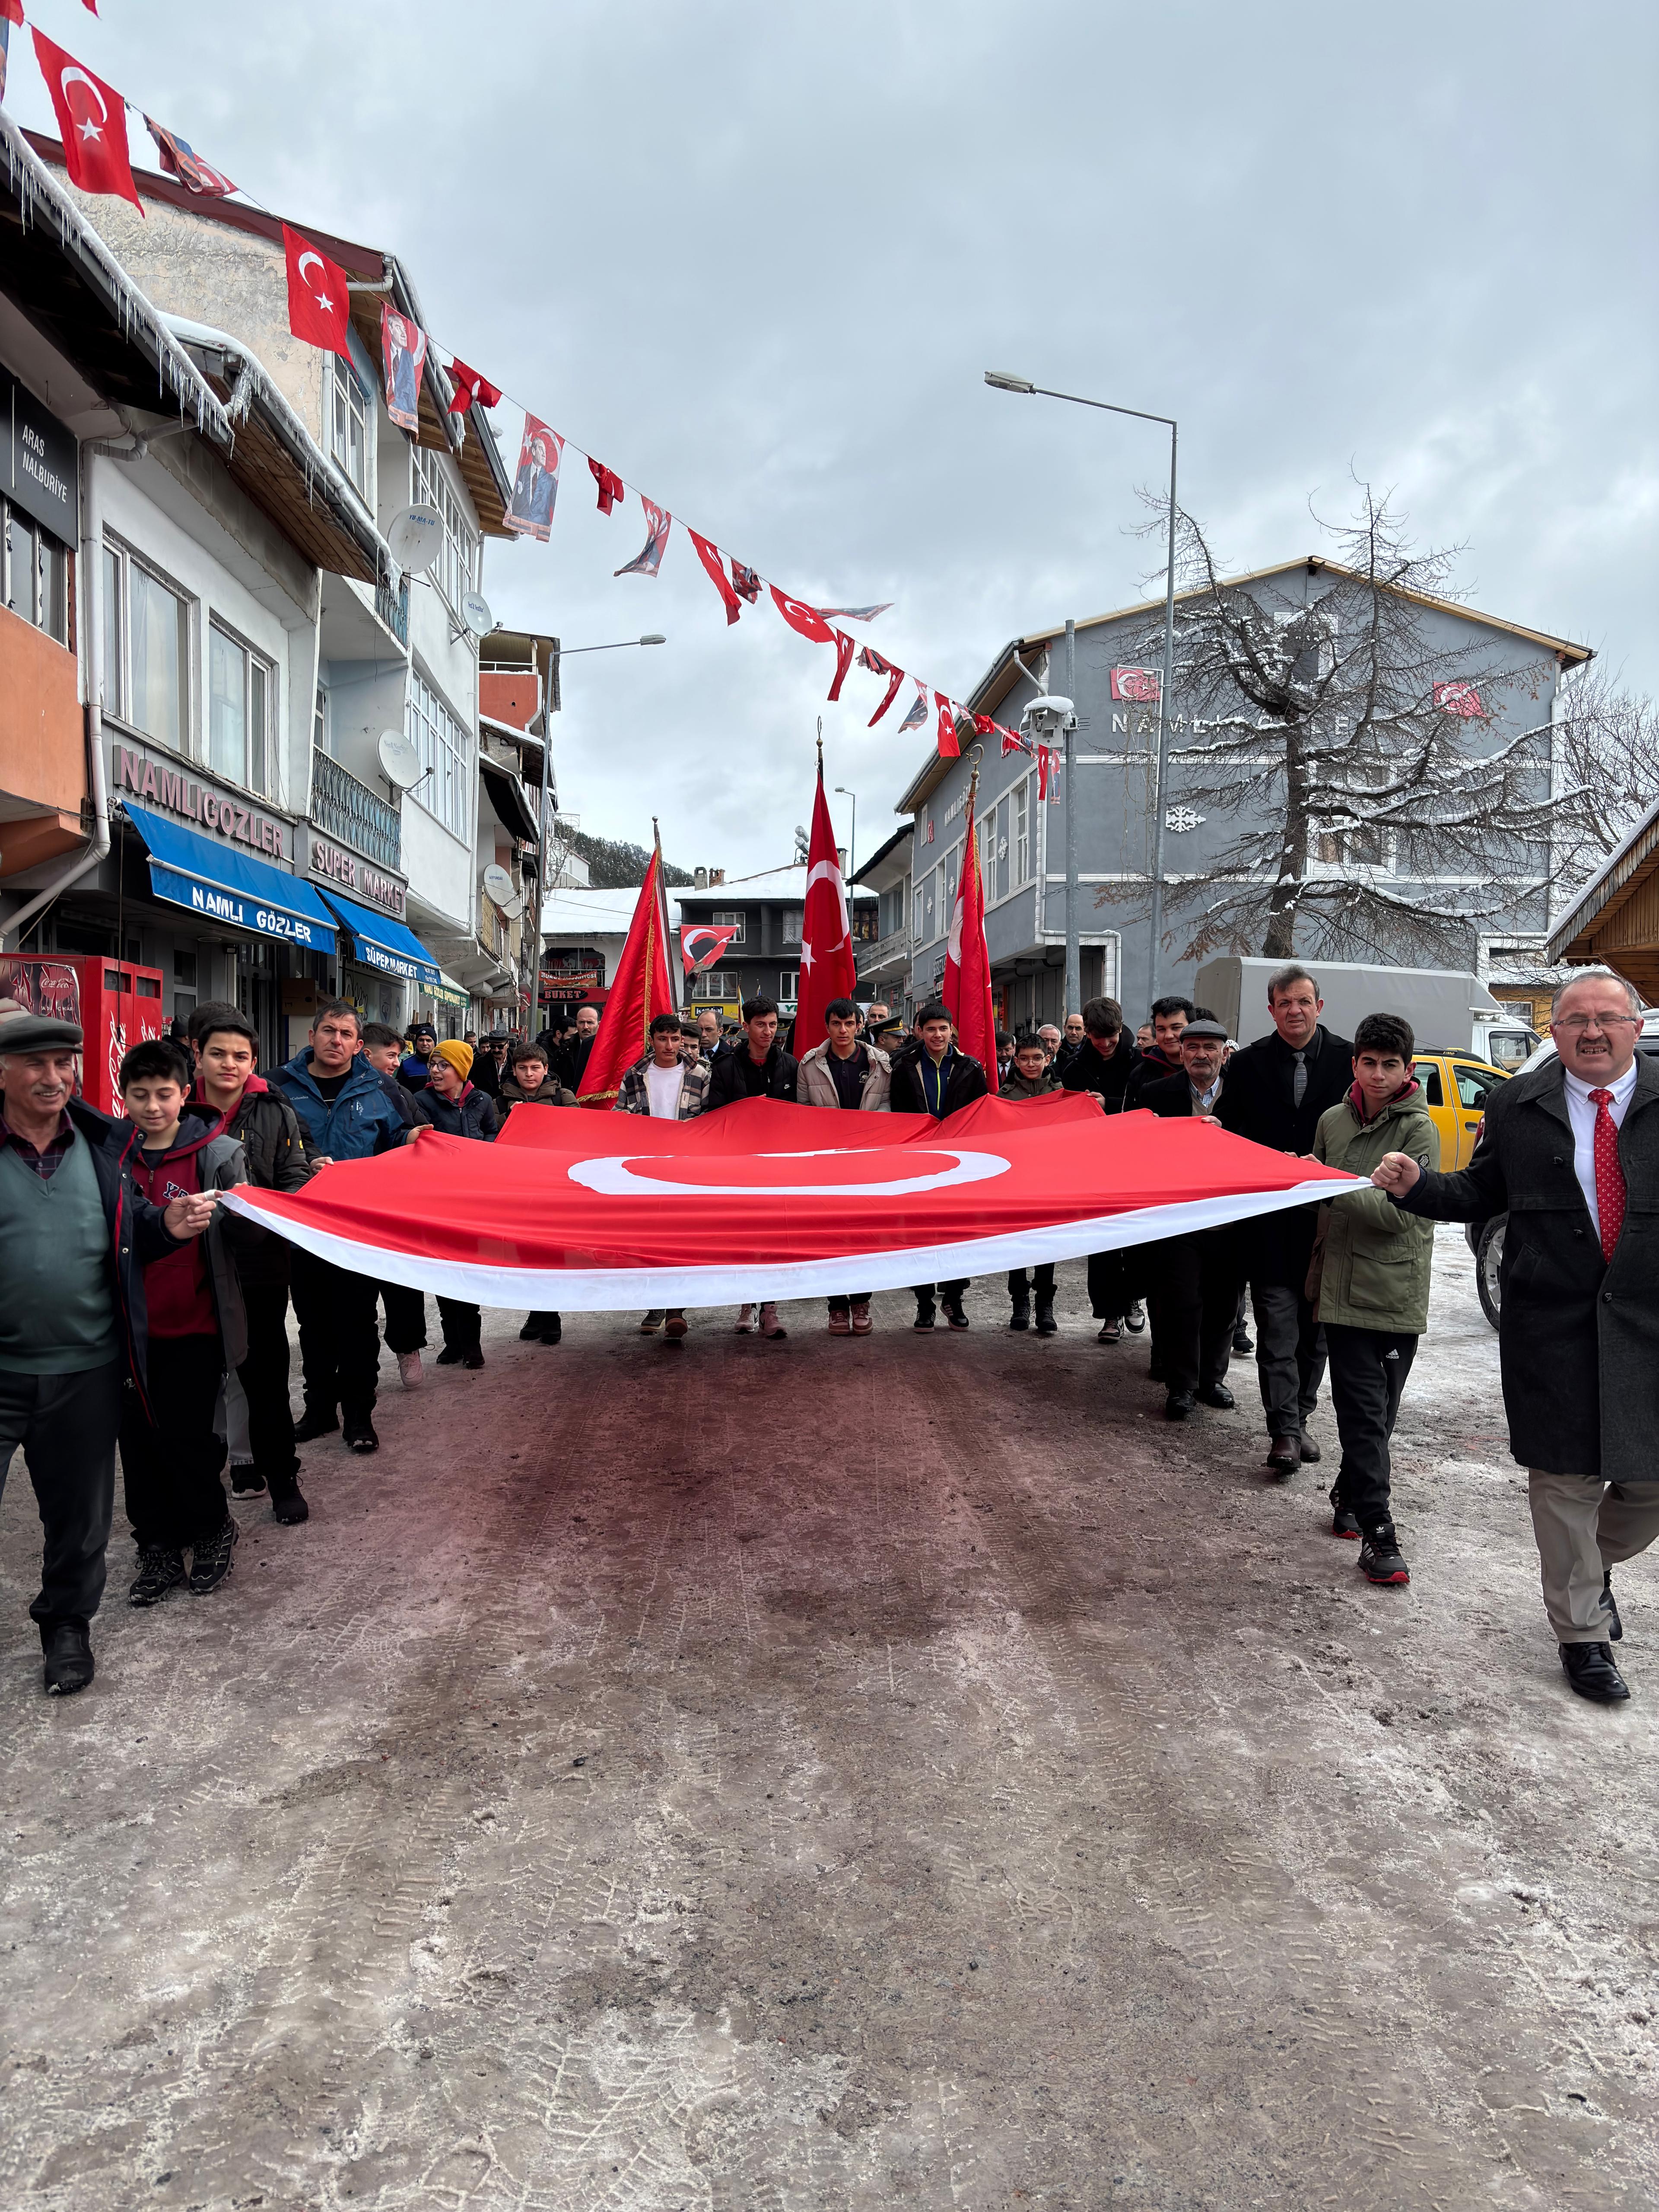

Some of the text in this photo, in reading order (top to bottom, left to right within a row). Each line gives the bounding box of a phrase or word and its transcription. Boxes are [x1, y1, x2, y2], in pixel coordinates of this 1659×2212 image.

[22, 425, 44, 457] ARAS
[22, 451, 67, 503] NALBURİYE
[360, 867, 405, 912] MARKET
[192, 886, 311, 943] NAMLI GÖZLER
[544, 990, 581, 998] BUKET
